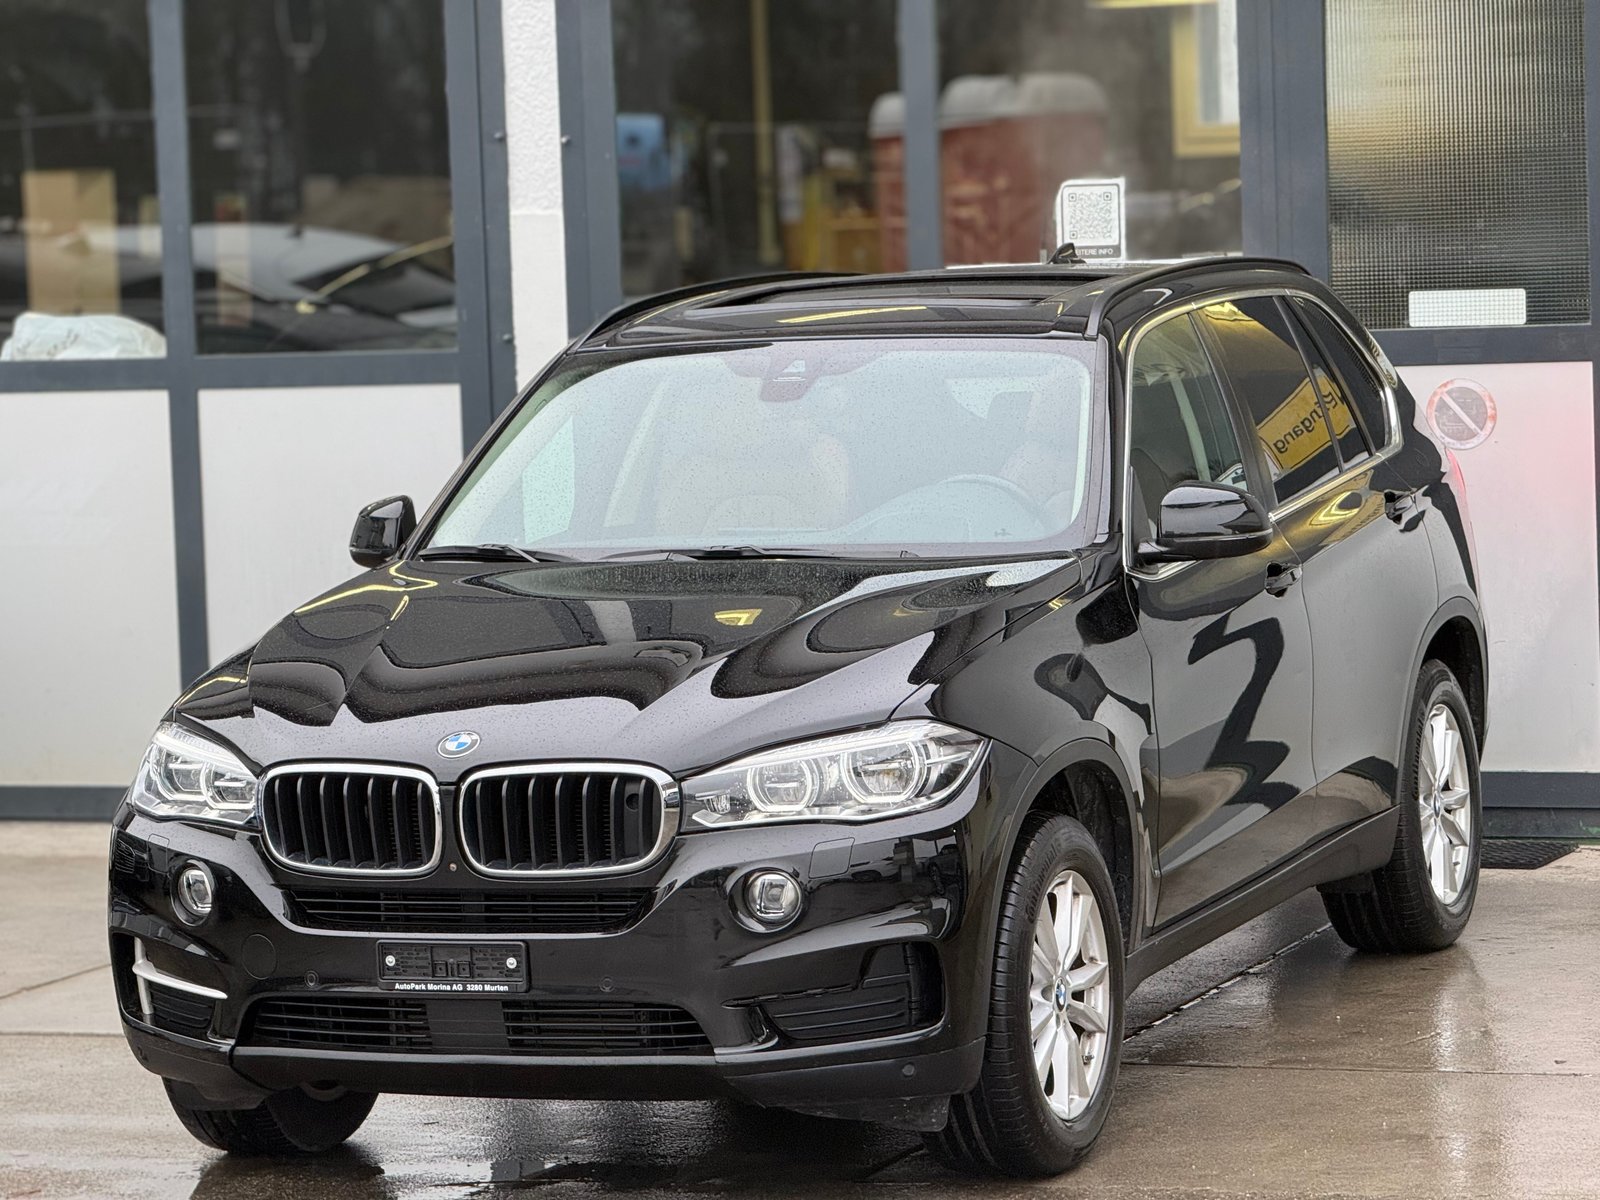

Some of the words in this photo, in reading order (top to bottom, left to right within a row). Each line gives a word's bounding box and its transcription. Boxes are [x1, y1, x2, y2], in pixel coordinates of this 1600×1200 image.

[1074, 248, 1097, 256] EITERE
[395, 982, 427, 991] AutoPark
[427, 983, 451, 991] Morina
[452, 983, 463, 991] AG
[484, 984, 509, 992] Murten
